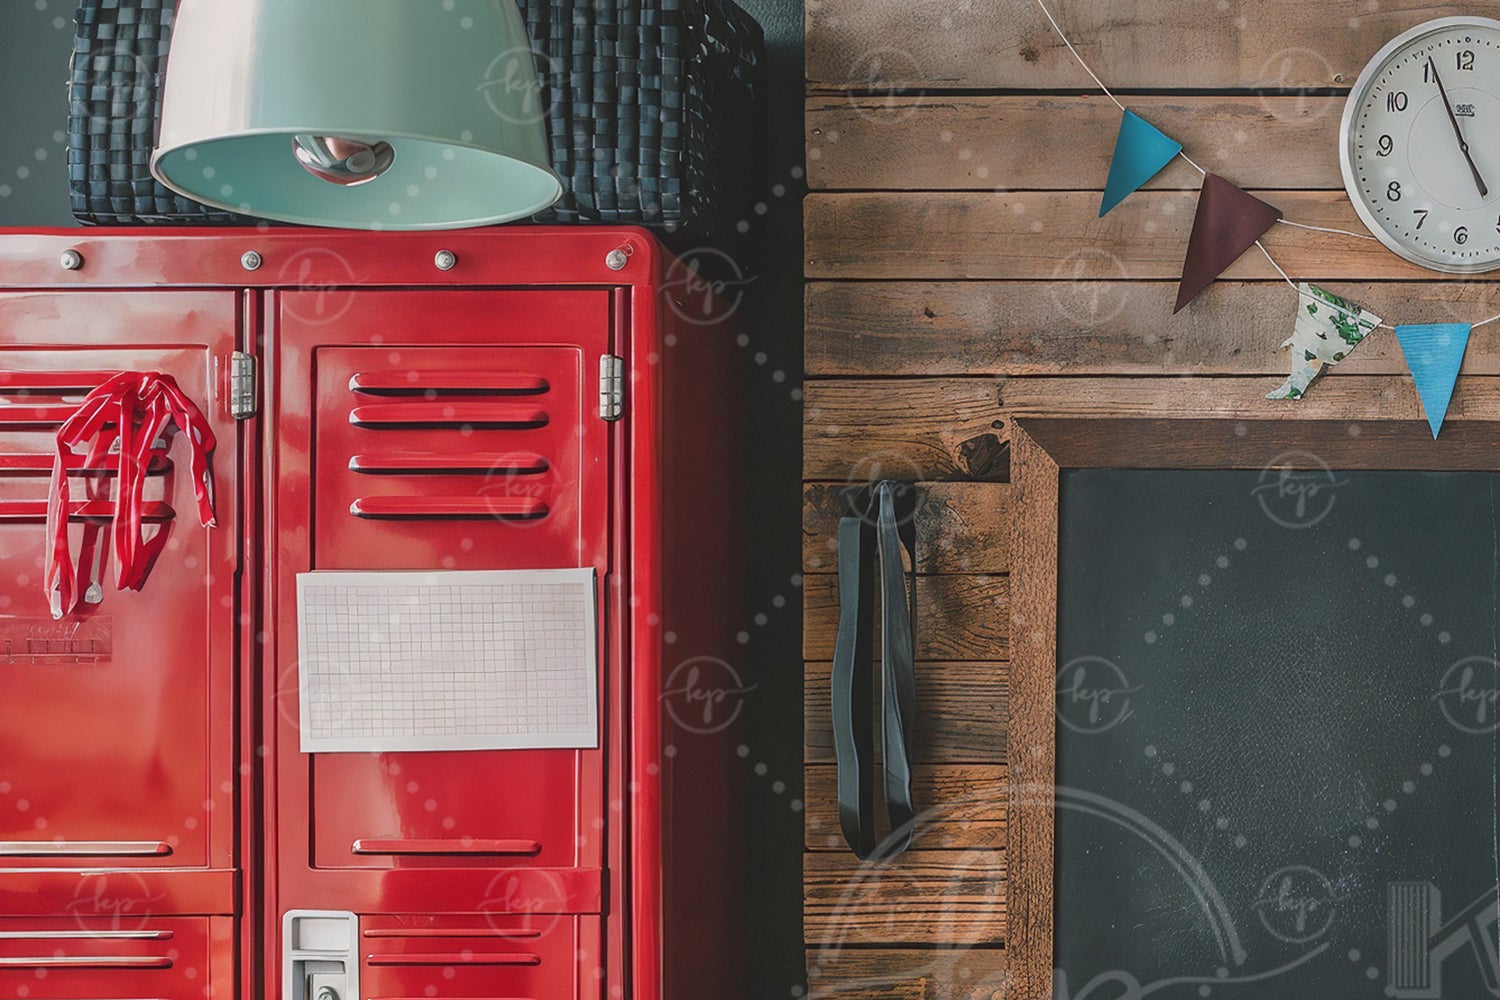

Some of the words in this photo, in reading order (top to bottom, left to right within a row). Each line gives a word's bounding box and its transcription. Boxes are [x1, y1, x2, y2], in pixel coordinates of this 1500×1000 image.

[1456, 50, 1475, 71] 12
[1387, 91, 1408, 112] 10
[1375, 134, 1394, 157] 9
[1386, 181, 1401, 202] 8
[1413, 209, 1429, 230] 7
[1453, 226, 1469, 245] 6
